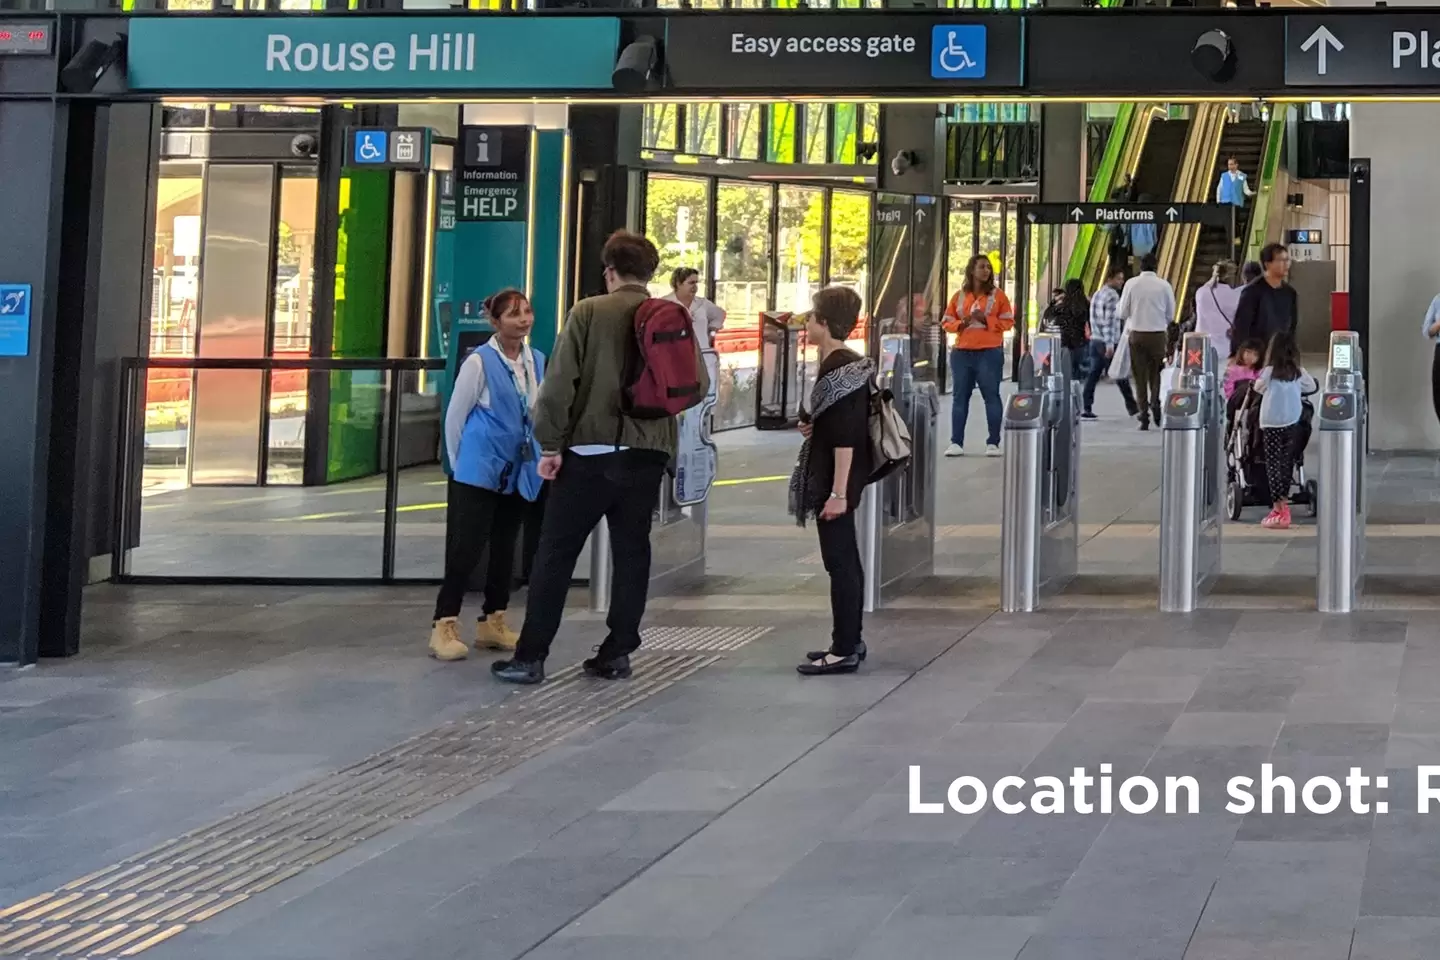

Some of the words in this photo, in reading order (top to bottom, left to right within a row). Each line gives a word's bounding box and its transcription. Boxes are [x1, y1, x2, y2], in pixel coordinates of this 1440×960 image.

[266, 34, 395, 72] Rouse
[409, 33, 475, 71] Hill
[731, 33, 782, 57] Easy
[785, 37, 862, 53] access
[866, 34, 916, 58] gate
[463, 170, 518, 180] Information
[464, 185, 518, 197] Emergency
[463, 197, 518, 217] HELP
[1095, 208, 1154, 220] Platforms
